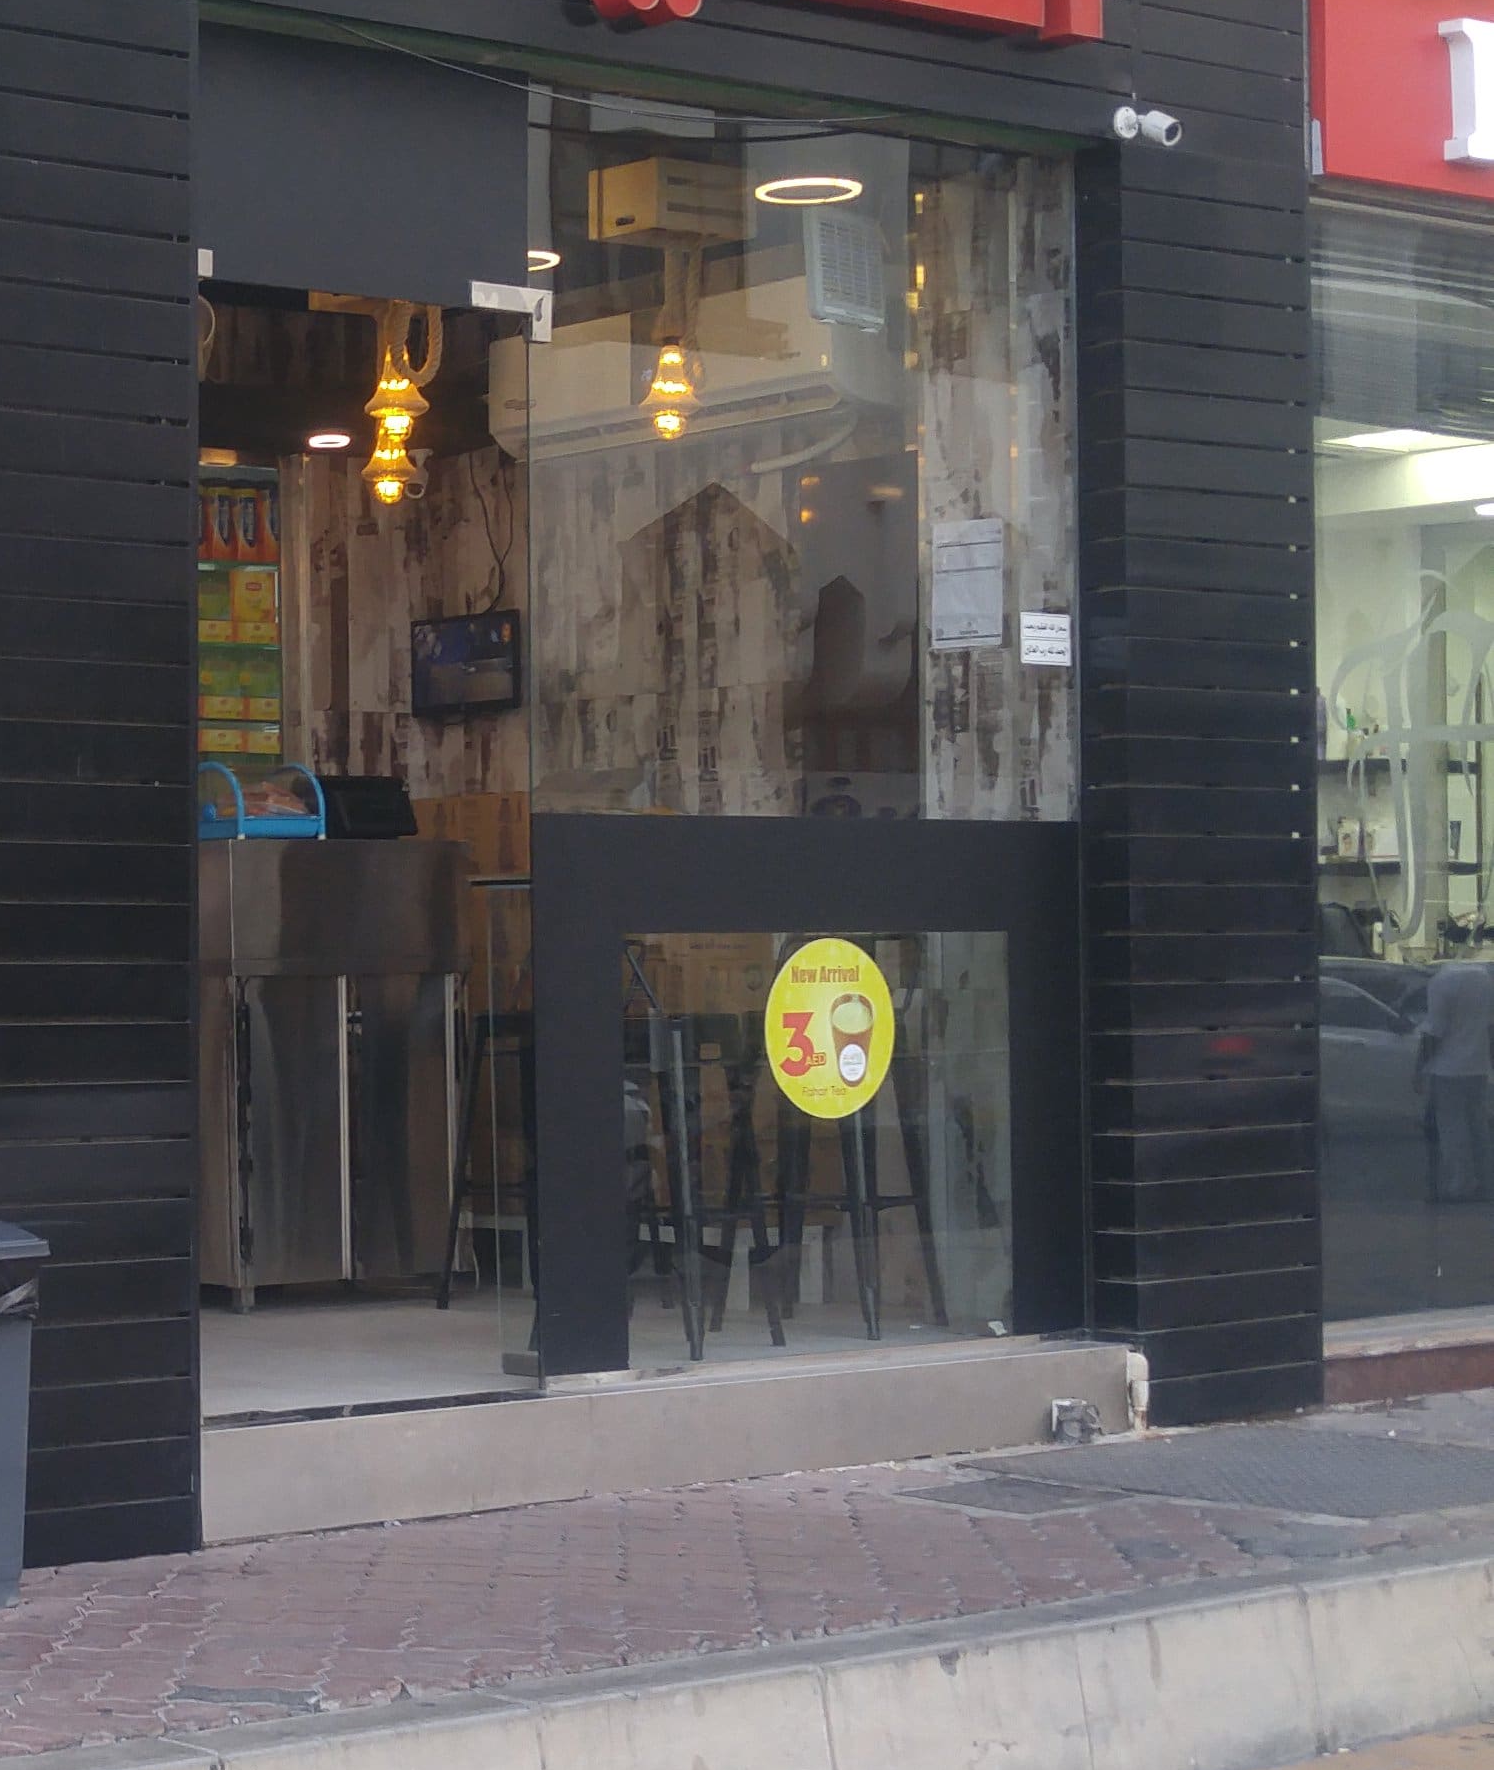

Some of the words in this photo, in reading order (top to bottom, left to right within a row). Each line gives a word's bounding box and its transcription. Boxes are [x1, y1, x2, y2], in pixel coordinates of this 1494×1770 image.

[791, 966, 817, 984] New
[819, 965, 860, 983] Arrival
[779, 1011, 815, 1077] 3
[806, 1051, 826, 1067] AED
